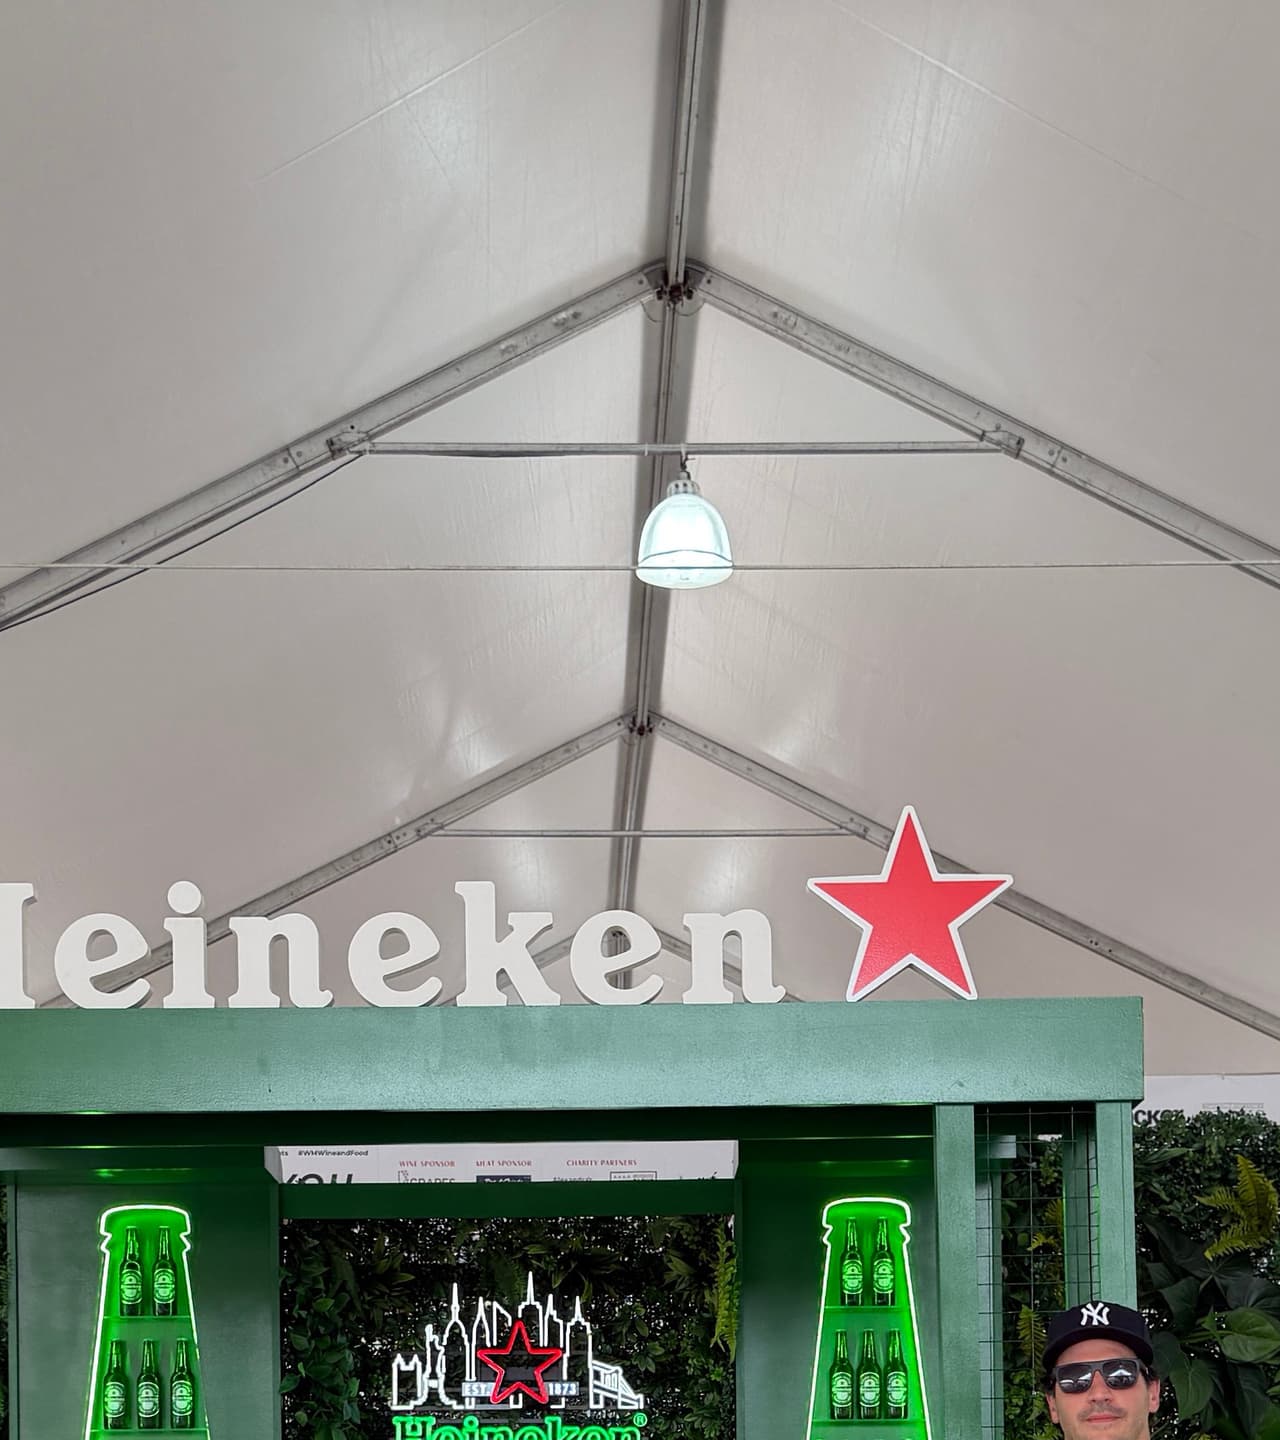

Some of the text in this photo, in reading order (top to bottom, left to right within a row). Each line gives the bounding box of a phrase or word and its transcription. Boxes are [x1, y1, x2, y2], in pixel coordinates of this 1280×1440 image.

[399, 1160, 455, 1168] WINE SPONSOR
[476, 1159, 532, 1167] MEAT SPONSOR
[566, 1159, 638, 1167] CHARITY PARTNERS
[1081, 1302, 1110, 1326] NY
[548, 1382, 577, 1395] 1873
